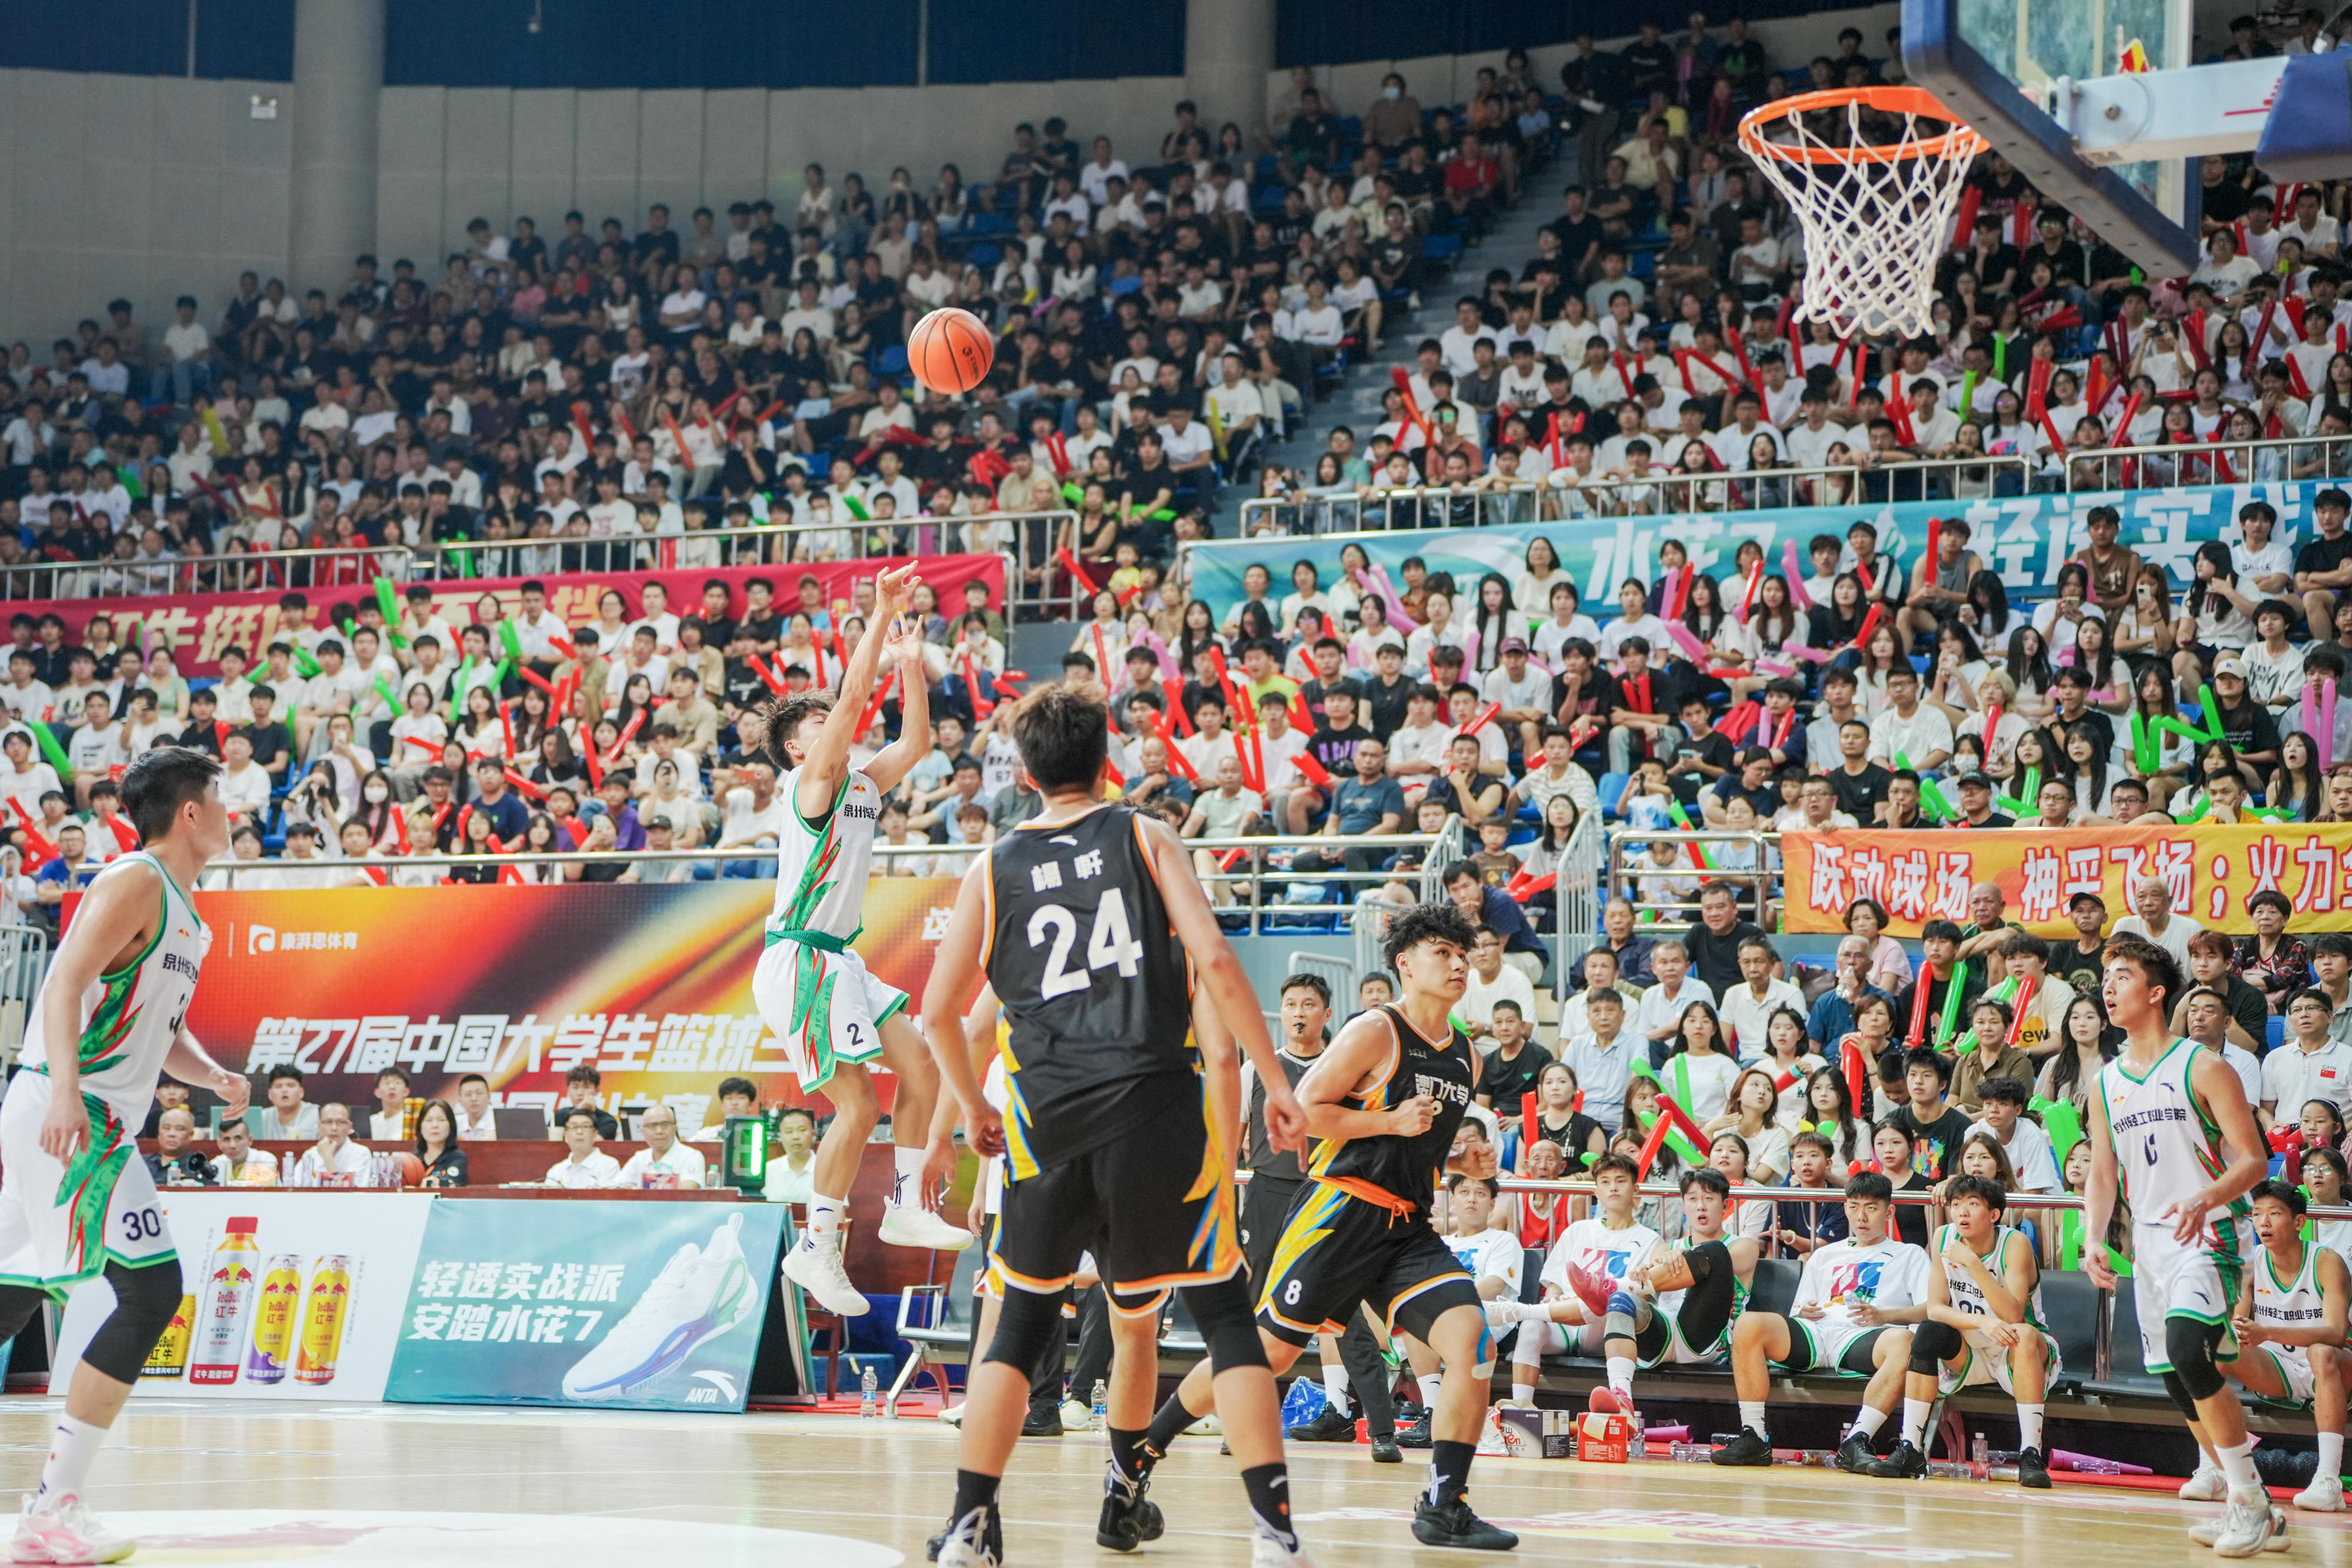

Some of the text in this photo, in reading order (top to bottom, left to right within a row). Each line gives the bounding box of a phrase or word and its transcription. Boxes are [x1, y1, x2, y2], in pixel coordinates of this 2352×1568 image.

[1965, 481, 2352, 587] 轻透实战
[1585, 516, 1777, 606] 水花7
[844, 804, 877, 820] 泉州轻
[1810, 837, 2352, 921] 跃动球场 神采飞扬；火力
[280, 931, 359, 950] 康湃思体育
[1027, 887, 1144, 1001] 24
[847, 1022, 864, 1046] 2
[1415, 1072, 1469, 1107] 澳门大学
[122, 1208, 161, 1241] 30
[417, 1261, 626, 1302] 轻透实战派
[1284, 1279, 1303, 1305] 8
[217, 1291, 242, 1303] RedBull
[269, 1301, 289, 1312] RedBull
[318, 1302, 338, 1312] RedBull
[215, 1306, 238, 1319] 红牛
[266, 1314, 286, 1324] 红牛
[315, 1315, 335, 1325] 红牛
[406, 1302, 604, 1343] 安踏水花7
[684, 1388, 719, 1403] ANTA
